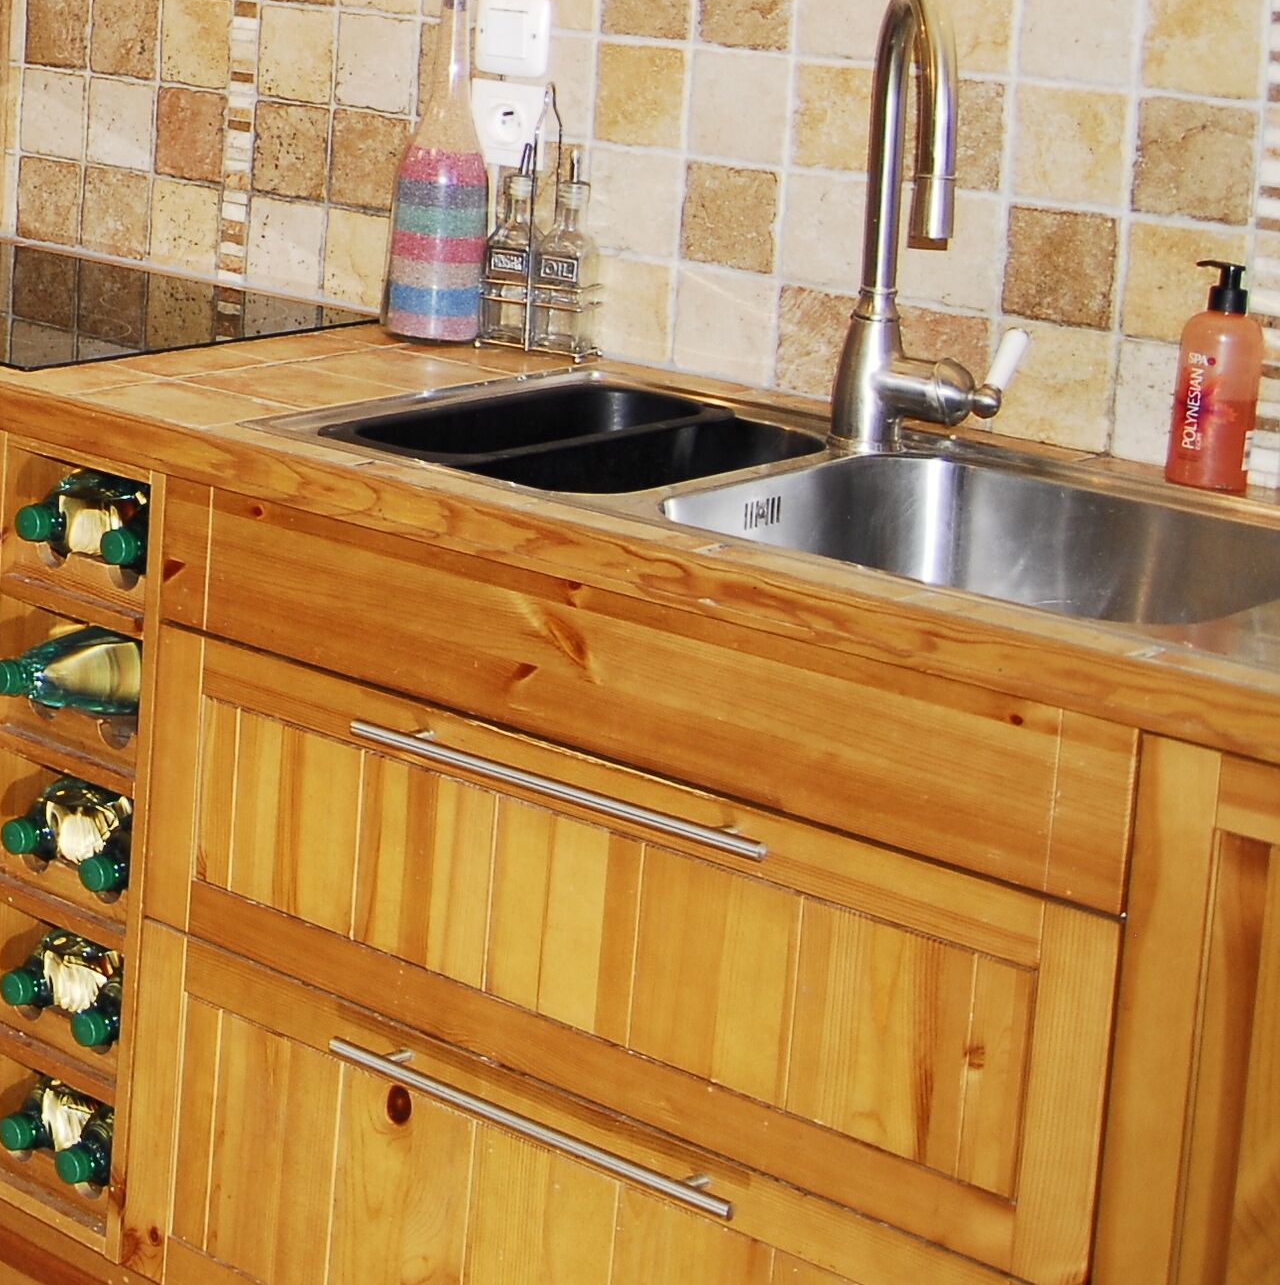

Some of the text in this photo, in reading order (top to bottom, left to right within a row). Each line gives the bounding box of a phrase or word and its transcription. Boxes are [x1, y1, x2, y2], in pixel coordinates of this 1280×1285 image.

[543, 259, 574, 278] OIL
[1188, 352, 1209, 366] SPA
[1181, 367, 1204, 450] POLYNESIAN
